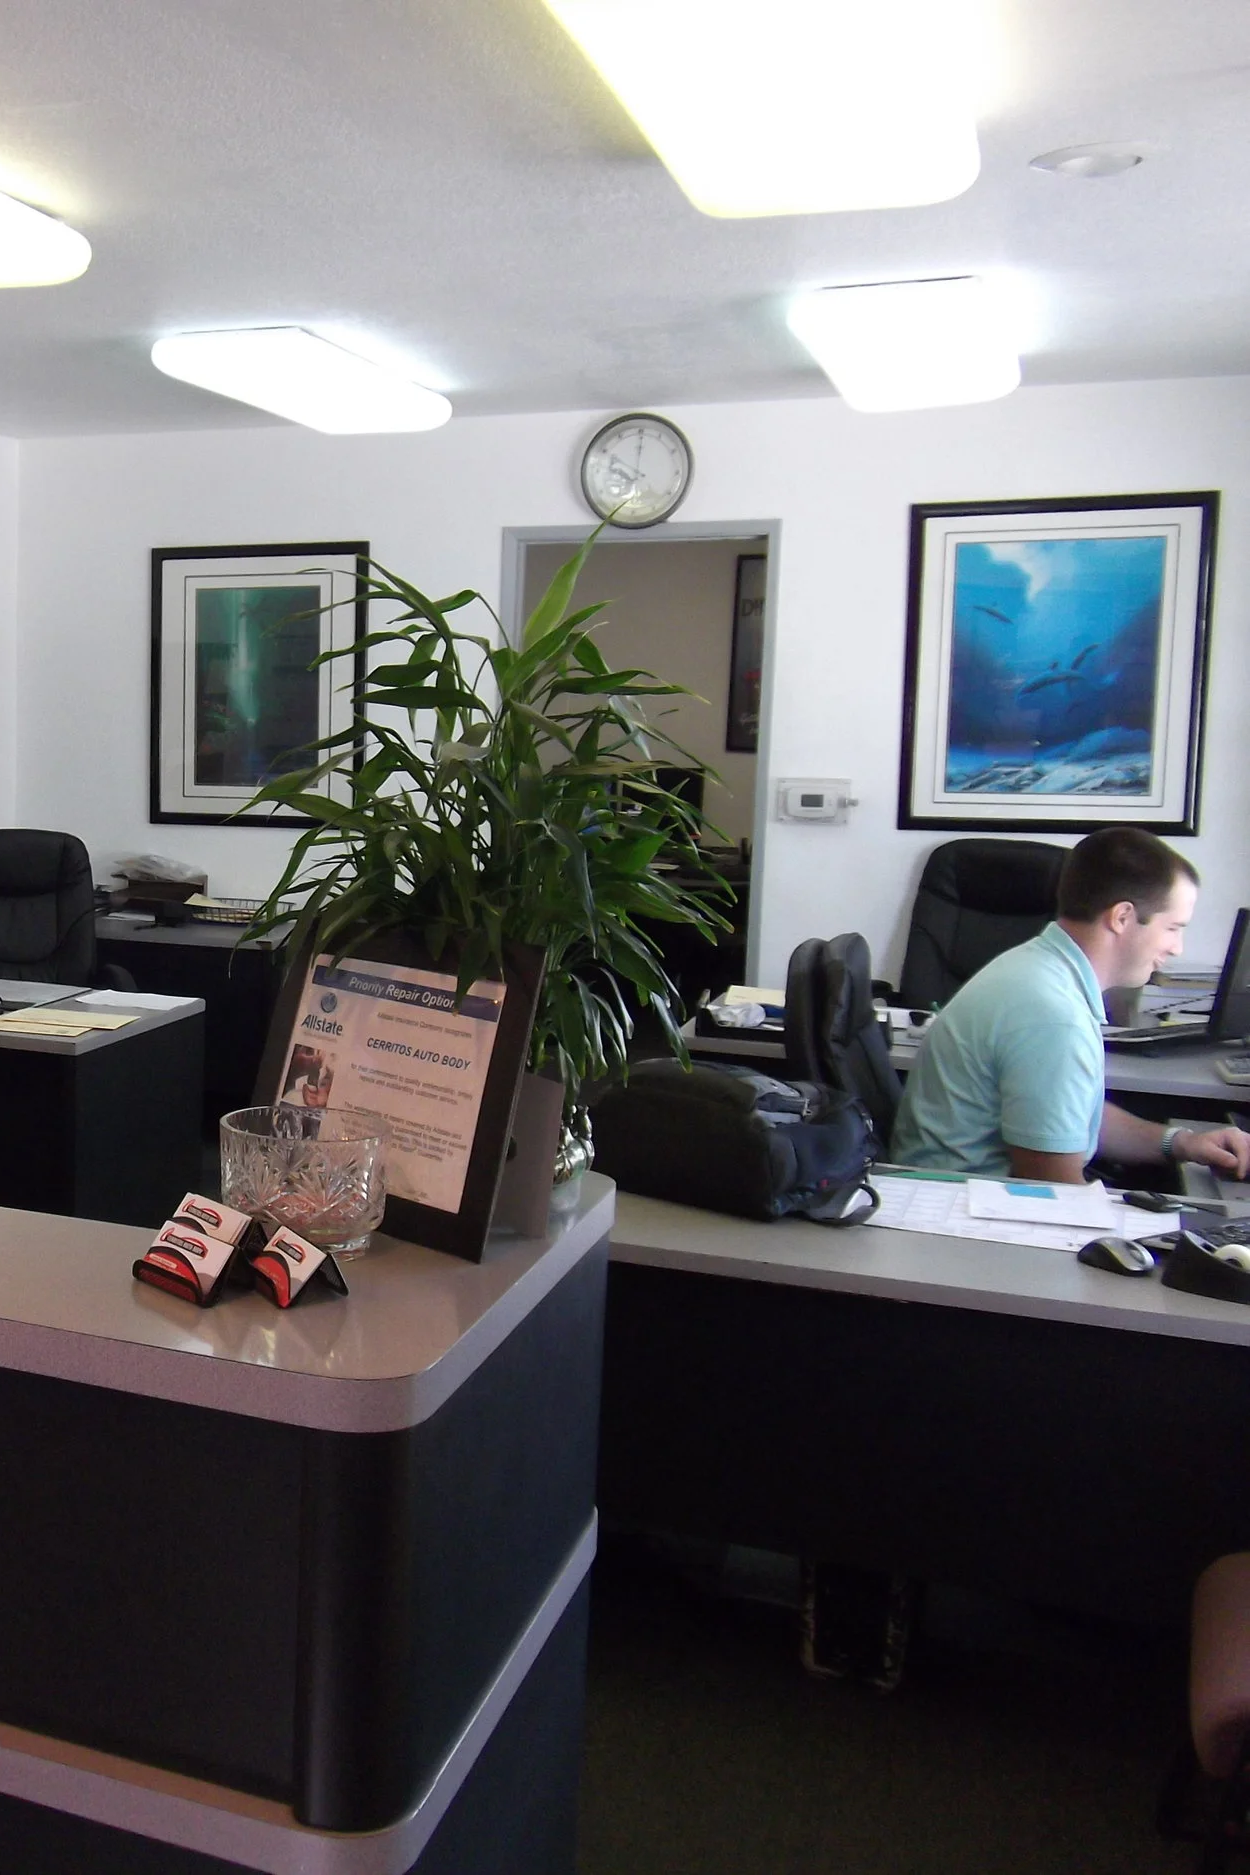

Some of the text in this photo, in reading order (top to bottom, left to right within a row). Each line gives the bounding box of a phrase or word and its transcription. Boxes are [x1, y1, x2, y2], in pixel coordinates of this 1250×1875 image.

[349, 976, 385, 997] Priority
[385, 984, 421, 1002] Repair
[301, 1014, 343, 1036] Allstate
[367, 1037, 471, 1070] CERRITOS AUTO BODY
